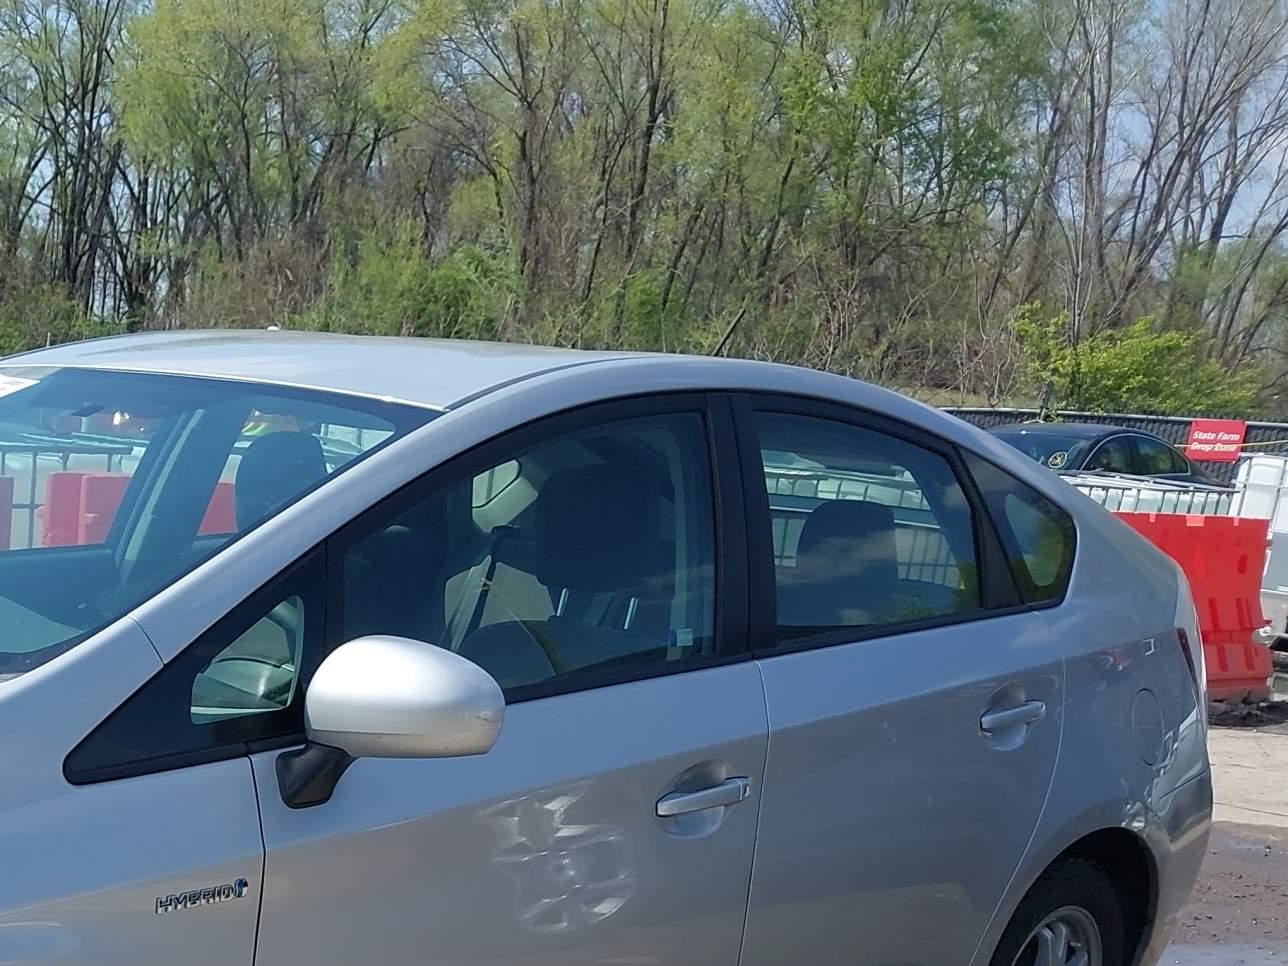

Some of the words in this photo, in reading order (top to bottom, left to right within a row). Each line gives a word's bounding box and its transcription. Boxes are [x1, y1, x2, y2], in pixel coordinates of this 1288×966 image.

[1193, 430, 1216, 440] State
[1217, 431, 1240, 441] Farm
[1191, 441, 1212, 452] Drop
[1213, 442, 1238, 452] Zone
[155, 884, 234, 914] HYBRID
